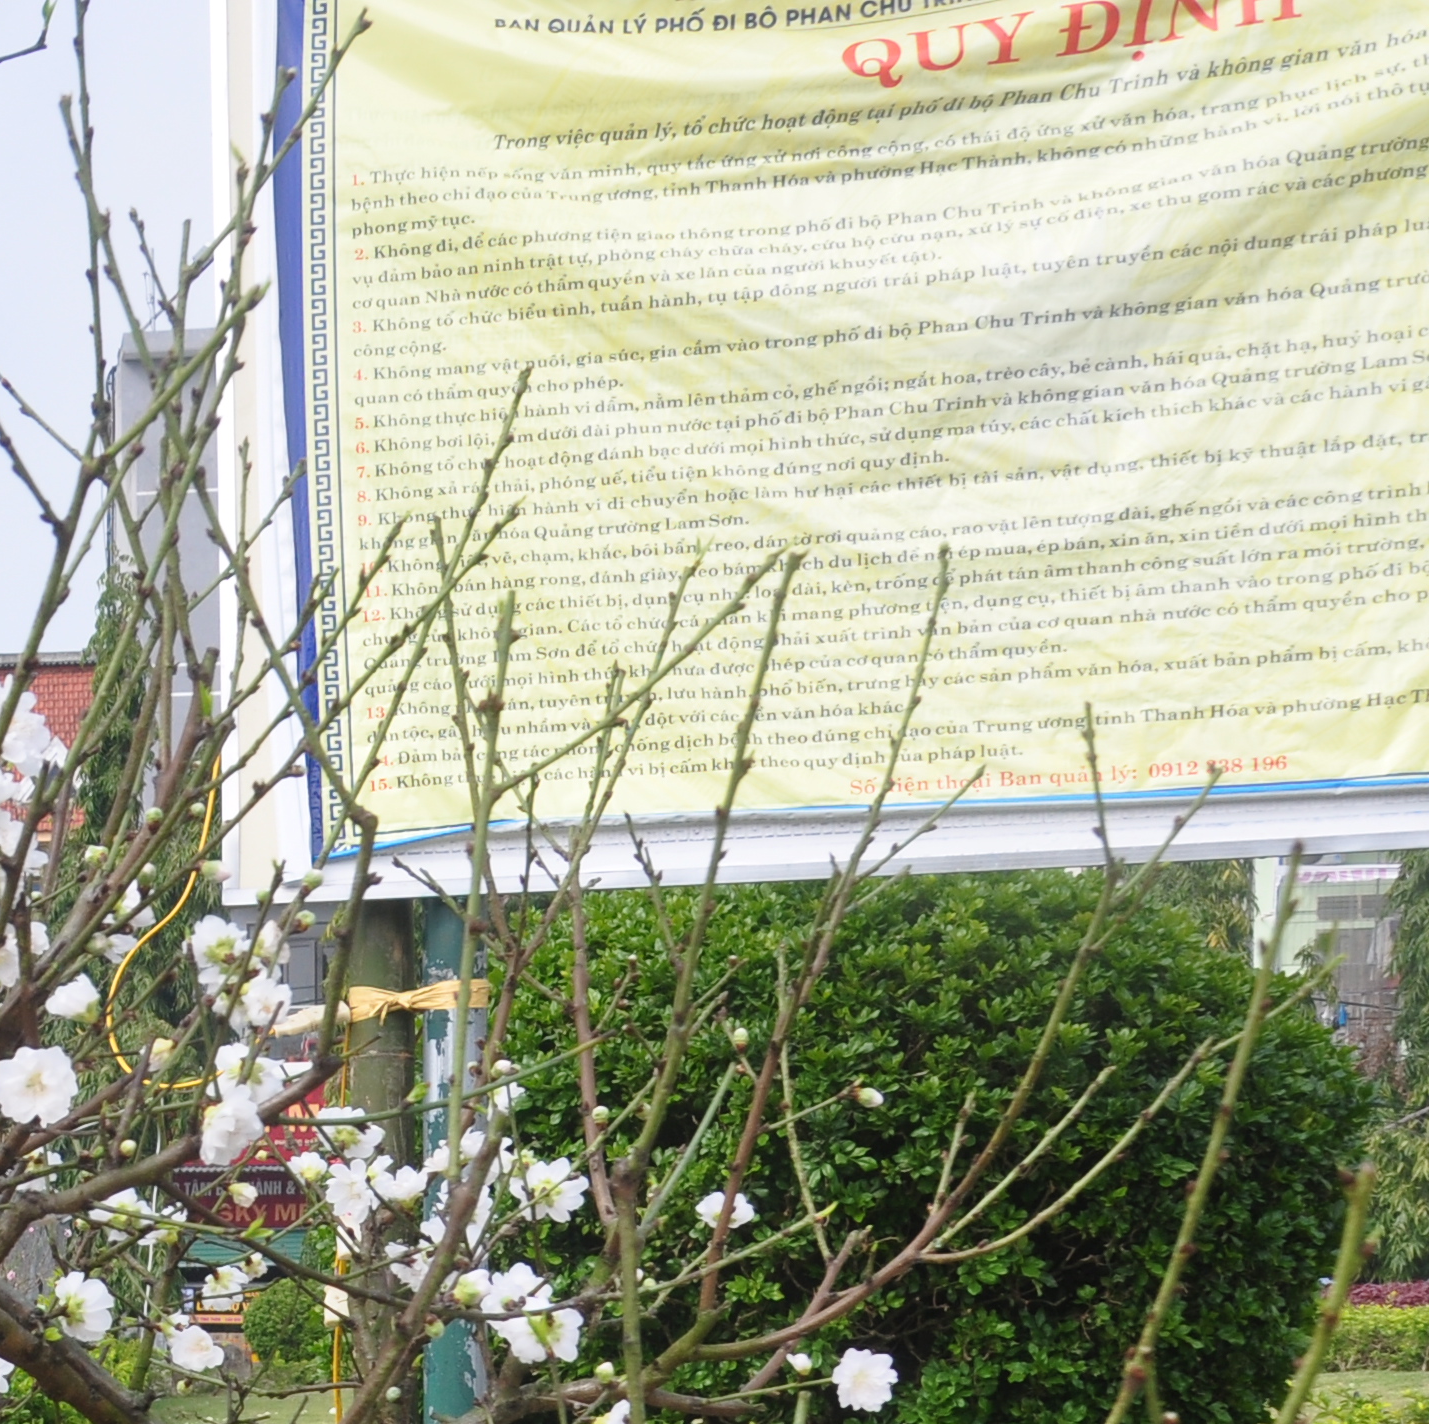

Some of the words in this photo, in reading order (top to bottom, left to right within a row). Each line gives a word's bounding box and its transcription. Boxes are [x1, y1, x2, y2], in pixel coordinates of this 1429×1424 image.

[548, 15, 613, 34] QUẢN
[623, 14, 646, 34] LÝ
[655, 8, 704, 33] PHỐ
[712, 14, 735, 31] ĐI
[786, 4, 851, 26] PHAN
[860, 0, 912, 18] CHU
[841, 10, 1035, 89] QUY
[493, 132, 550, 152] Trong
[556, 128, 594, 149] việc
[599, 123, 647, 145] quản
[654, 120, 676, 141] lý,
[683, 116, 706, 136] tổ
[708, 115, 756, 134] chức
[761, 112, 806, 133] hoạt
[811, 106, 862, 129] động
[866, 103, 894, 124] tại
[896, 96, 941, 120] phố
[941, 96, 966, 112] đi
[967, 93, 994, 113] bộ
[999, 88, 1052, 106] Phan
[1058, 80, 1100, 100] Chu
[1108, 69, 1168, 93] Trinh
[1176, 64, 1200, 82] và
[1206, 55, 1275, 80] không
[1279, 47, 1328, 70] gian
[1336, 38, 1377, 57] văn
[1386, 28, 1427, 47] hóa
[352, 219, 407, 240] phong
[411, 215, 437, 232] mỹ
[442, 214, 475, 231] tục.
[352, 367, 368, 381] 4.
[373, 364, 431, 382] Không
[436, 362, 487, 378] mang
[491, 357, 519, 377] vật
[575, 351, 603, 369] gia
[608, 347, 644, 364] súc,
[649, 344, 676, 364] gia
[683, 338, 721, 357] cầm
[726, 337, 759, 353] vào
[764, 333, 817, 351] trong
[823, 325, 861, 348] phố
[864, 325, 882, 340] đi
[889, 322, 911, 342] bộ
[917, 318, 968, 336] Phan
[974, 313, 1014, 330] Chu
[1020, 307, 1075, 325] Trinh
[1081, 305, 1103, 320] và
[1109, 299, 1170, 320] không
[1175, 295, 1217, 315] gian
[1223, 290, 1260, 307] văn
[1267, 285, 1302, 302] hóa
[1309, 277, 1380, 300] Quảng
[354, 416, 369, 430] 5.
[373, 412, 431, 431] Không
[435, 410, 476, 427] thực
[524, 402, 569, 418] hành
[575, 401, 590, 414] vi
[643, 391, 682, 410] nằm
[687, 392, 716, 407] lên
[720, 387, 768, 405] thảm
[772, 384, 798, 402] cỏ,
[802, 379, 839, 401] ghế
[893, 370, 936, 392] ngắt
[941, 369, 981, 386] hoa,
[985, 365, 1025, 381] trèo
[1028, 362, 1064, 381] cây,
[1069, 357, 1090, 375] bẻ
[1094, 353, 1147, 374] cành,
[1152, 349, 1183, 366] hái
[1187, 345, 1231, 366] quả,
[1236, 340, 1282, 360] chặt
[1286, 337, 1317, 356] hạ,
[1366, 324, 1411, 346] hoại
[355, 440, 369, 454] 6.
[373, 436, 432, 455] Không
[436, 433, 462, 448] bơi
[468, 431, 495, 451] lội,
[537, 425, 578, 442] dưới
[582, 424, 609, 439] đài
[615, 421, 661, 440] phun
[667, 418, 711, 433] nước
[716, 415, 740, 434] tại
[745, 409, 784, 432] phố
[784, 409, 801, 424] đi
[807, 407, 829, 426] bộ
[834, 404, 883, 421] Phan
[889, 400, 927, 416] Chu
[933, 394, 986, 412] Trinh
[991, 392, 1012, 407] và
[1018, 387, 1078, 407] không
[1082, 384, 1124, 403] gian
[1129, 379, 1165, 395] văn
[1170, 375, 1206, 391] hóa
[1211, 366, 1278, 390] Quảng
[1284, 359, 1356, 381] trường
[1361, 354, 1407, 371] Lam
[357, 489, 370, 503] 8.
[375, 484, 433, 504] Không
[437, 481, 457, 497] xả
[462, 479, 490, 497] rá
[494, 477, 535, 497] thải,
[539, 474, 595, 494] phóng
[630, 465, 666, 484] tiểu
[671, 465, 707, 484] tiện
[712, 463, 768, 480] không
[773, 460, 821, 478] đúng
[826, 457, 855, 472] nơi
[860, 457, 895, 473] quy
[900, 449, 949, 469] định.
[850, 776, 878, 795] Số
[1000, 770, 1042, 786] Ban
[1111, 764, 1137, 784] lý:
[1148, 760, 1199, 777] 0912
[1252, 754, 1288, 771] 196
